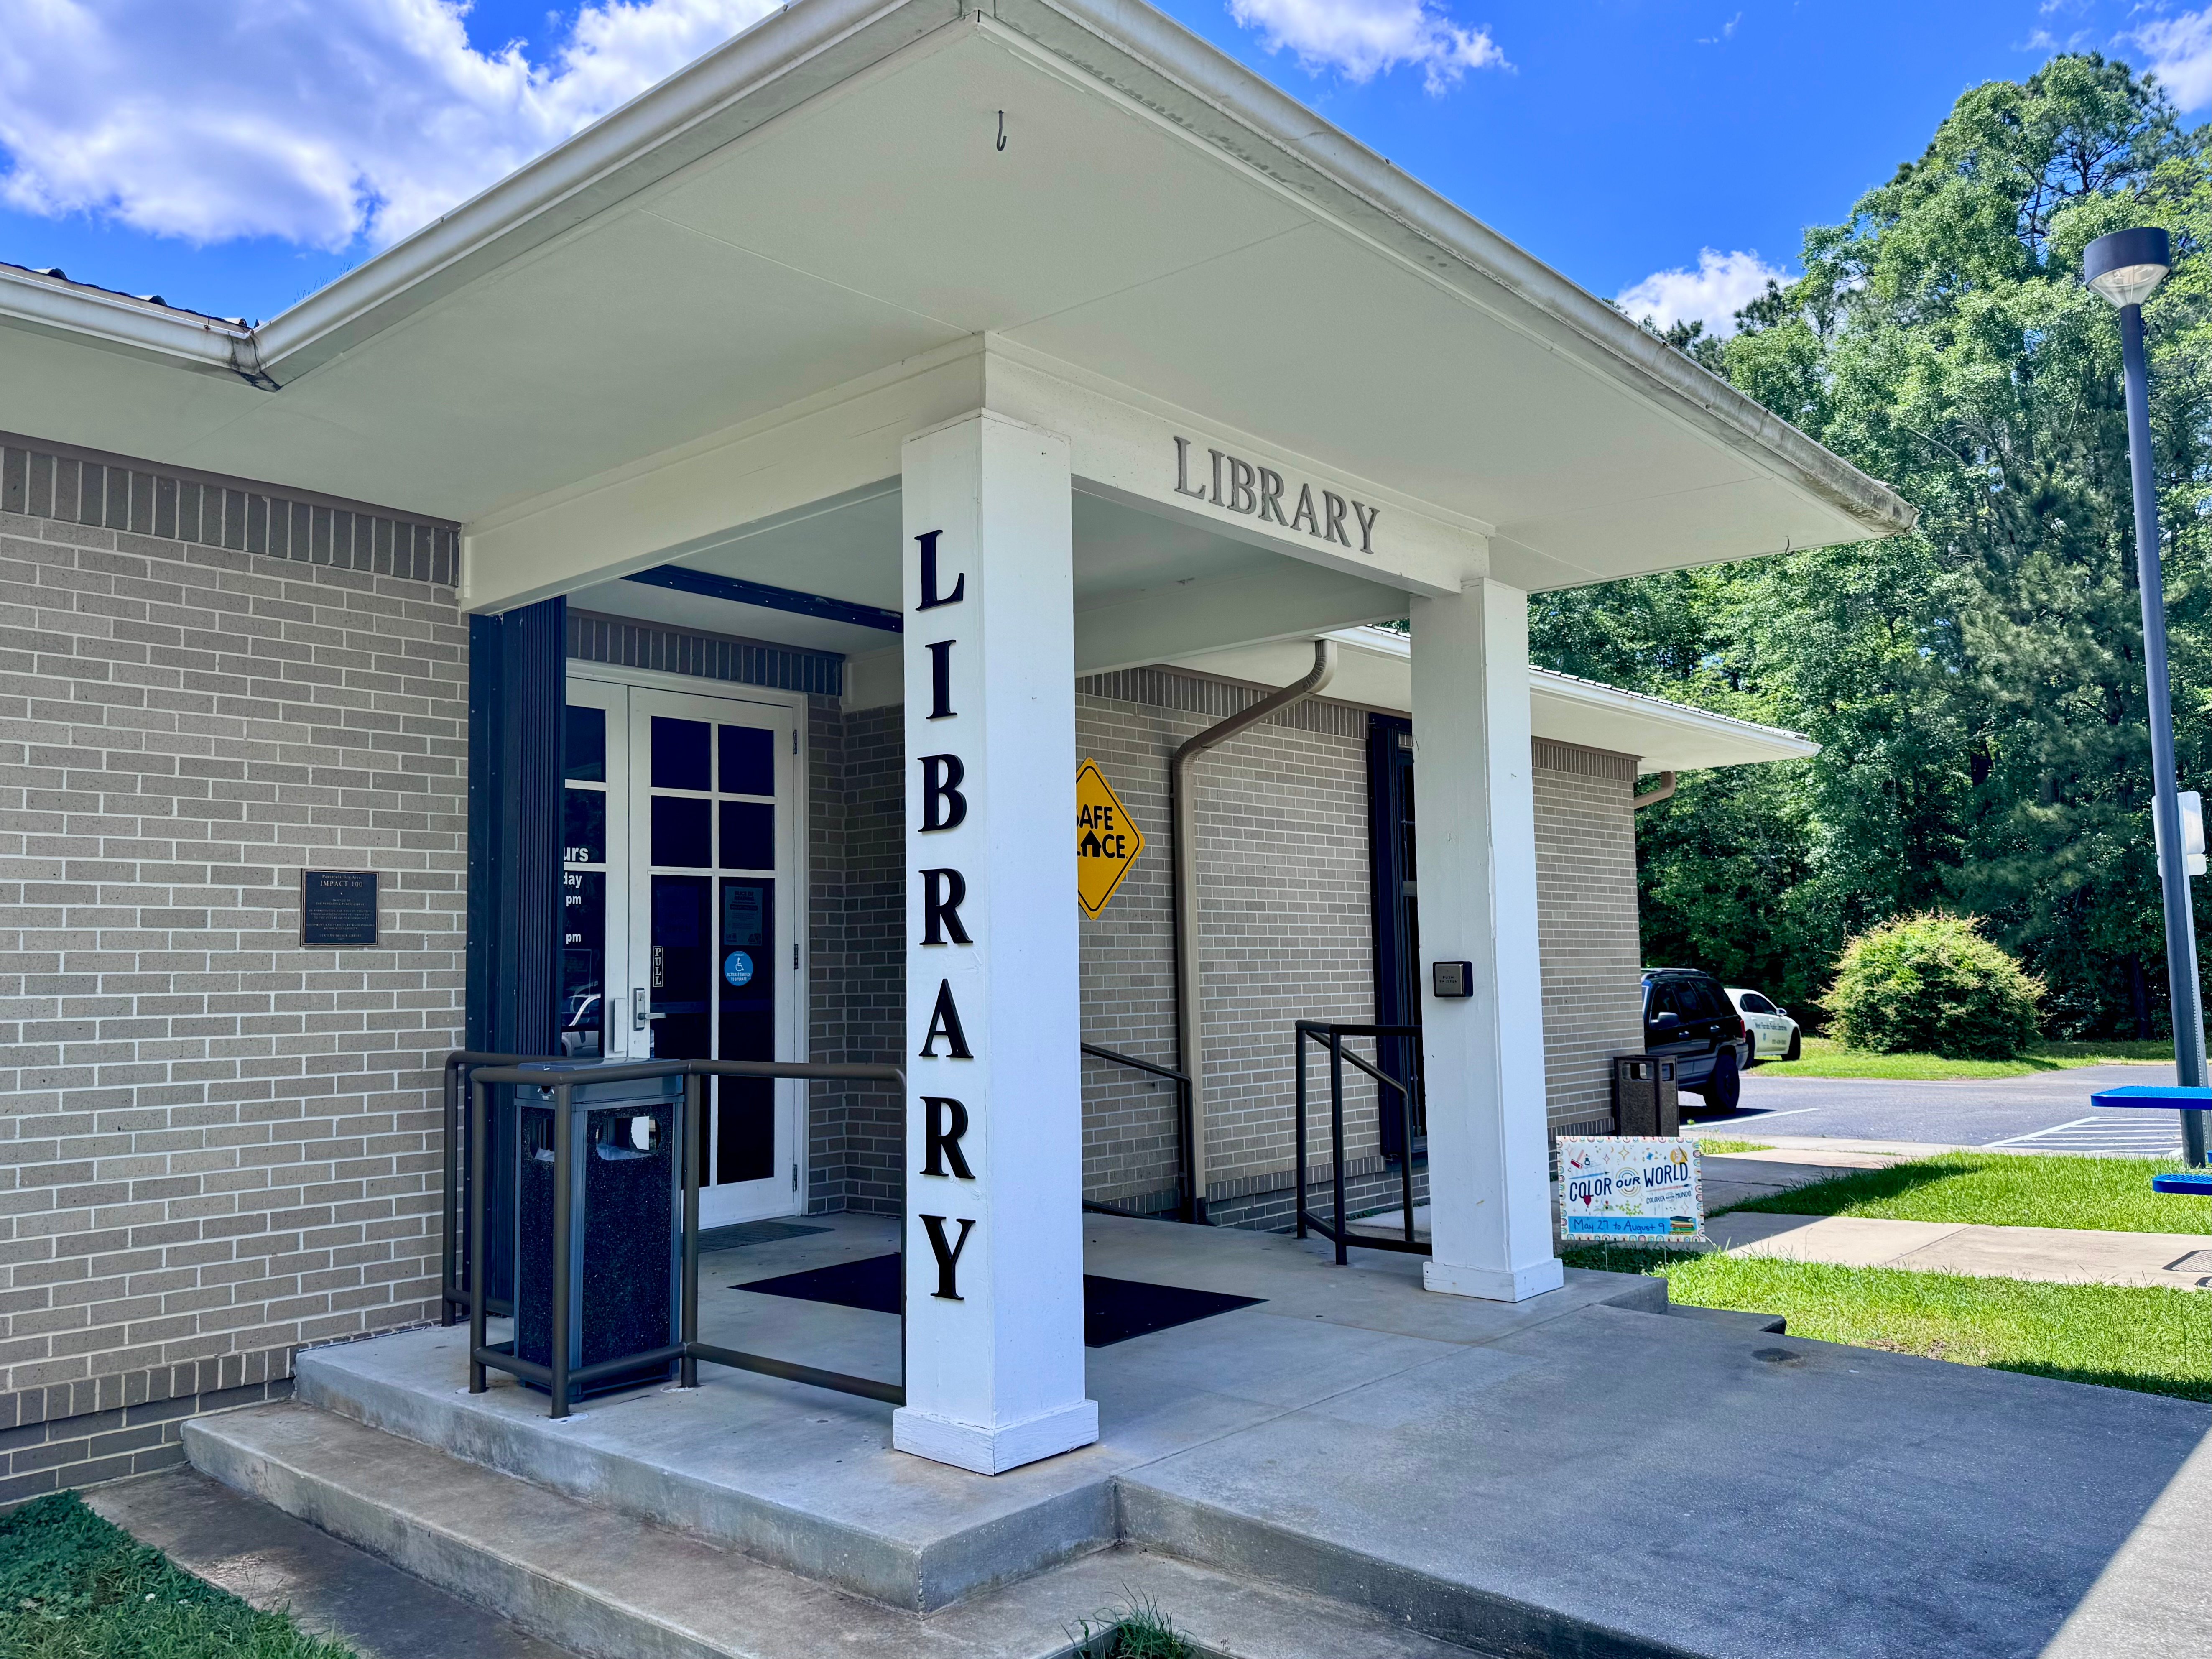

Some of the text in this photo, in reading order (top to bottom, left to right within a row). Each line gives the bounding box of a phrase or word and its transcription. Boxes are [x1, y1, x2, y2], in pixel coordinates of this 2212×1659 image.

[1173, 436, 1380, 554] LIBRARY
[564, 847, 589, 862] urs
[564, 872, 582, 888] day
[566, 896, 582, 907] pm
[914, 529, 975, 1301] LIBRARY
[566, 933, 582, 944] pm
[1569, 1162, 1688, 1202] COLOR OUR WORLD
[1646, 1196, 1666, 1204] COLOREA
[1574, 1219, 1665, 1234] May 27 to August 9
